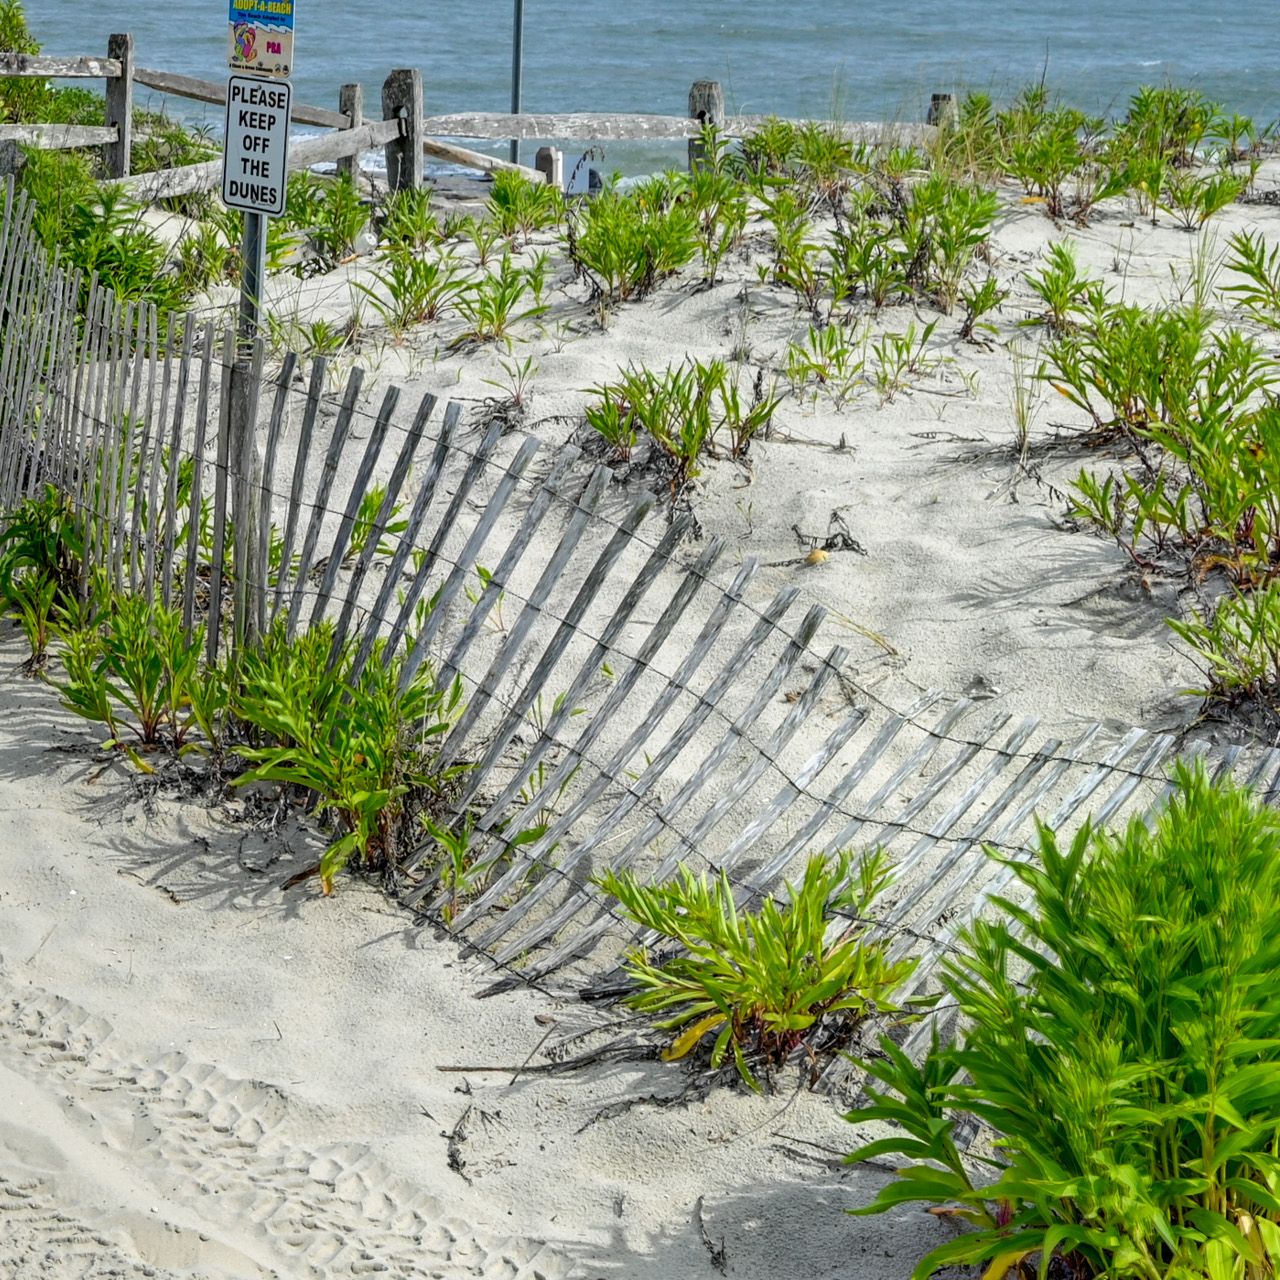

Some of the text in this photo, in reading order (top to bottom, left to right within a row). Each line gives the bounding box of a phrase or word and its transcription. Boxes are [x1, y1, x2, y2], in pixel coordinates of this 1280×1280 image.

[267, 41, 281, 54] PBA
[232, 86, 286, 109] PLEASE
[239, 111, 276, 131] KEEP
[243, 136, 270, 153] OFF
[241, 158, 269, 178] THE
[230, 181, 277, 204] DUNES
